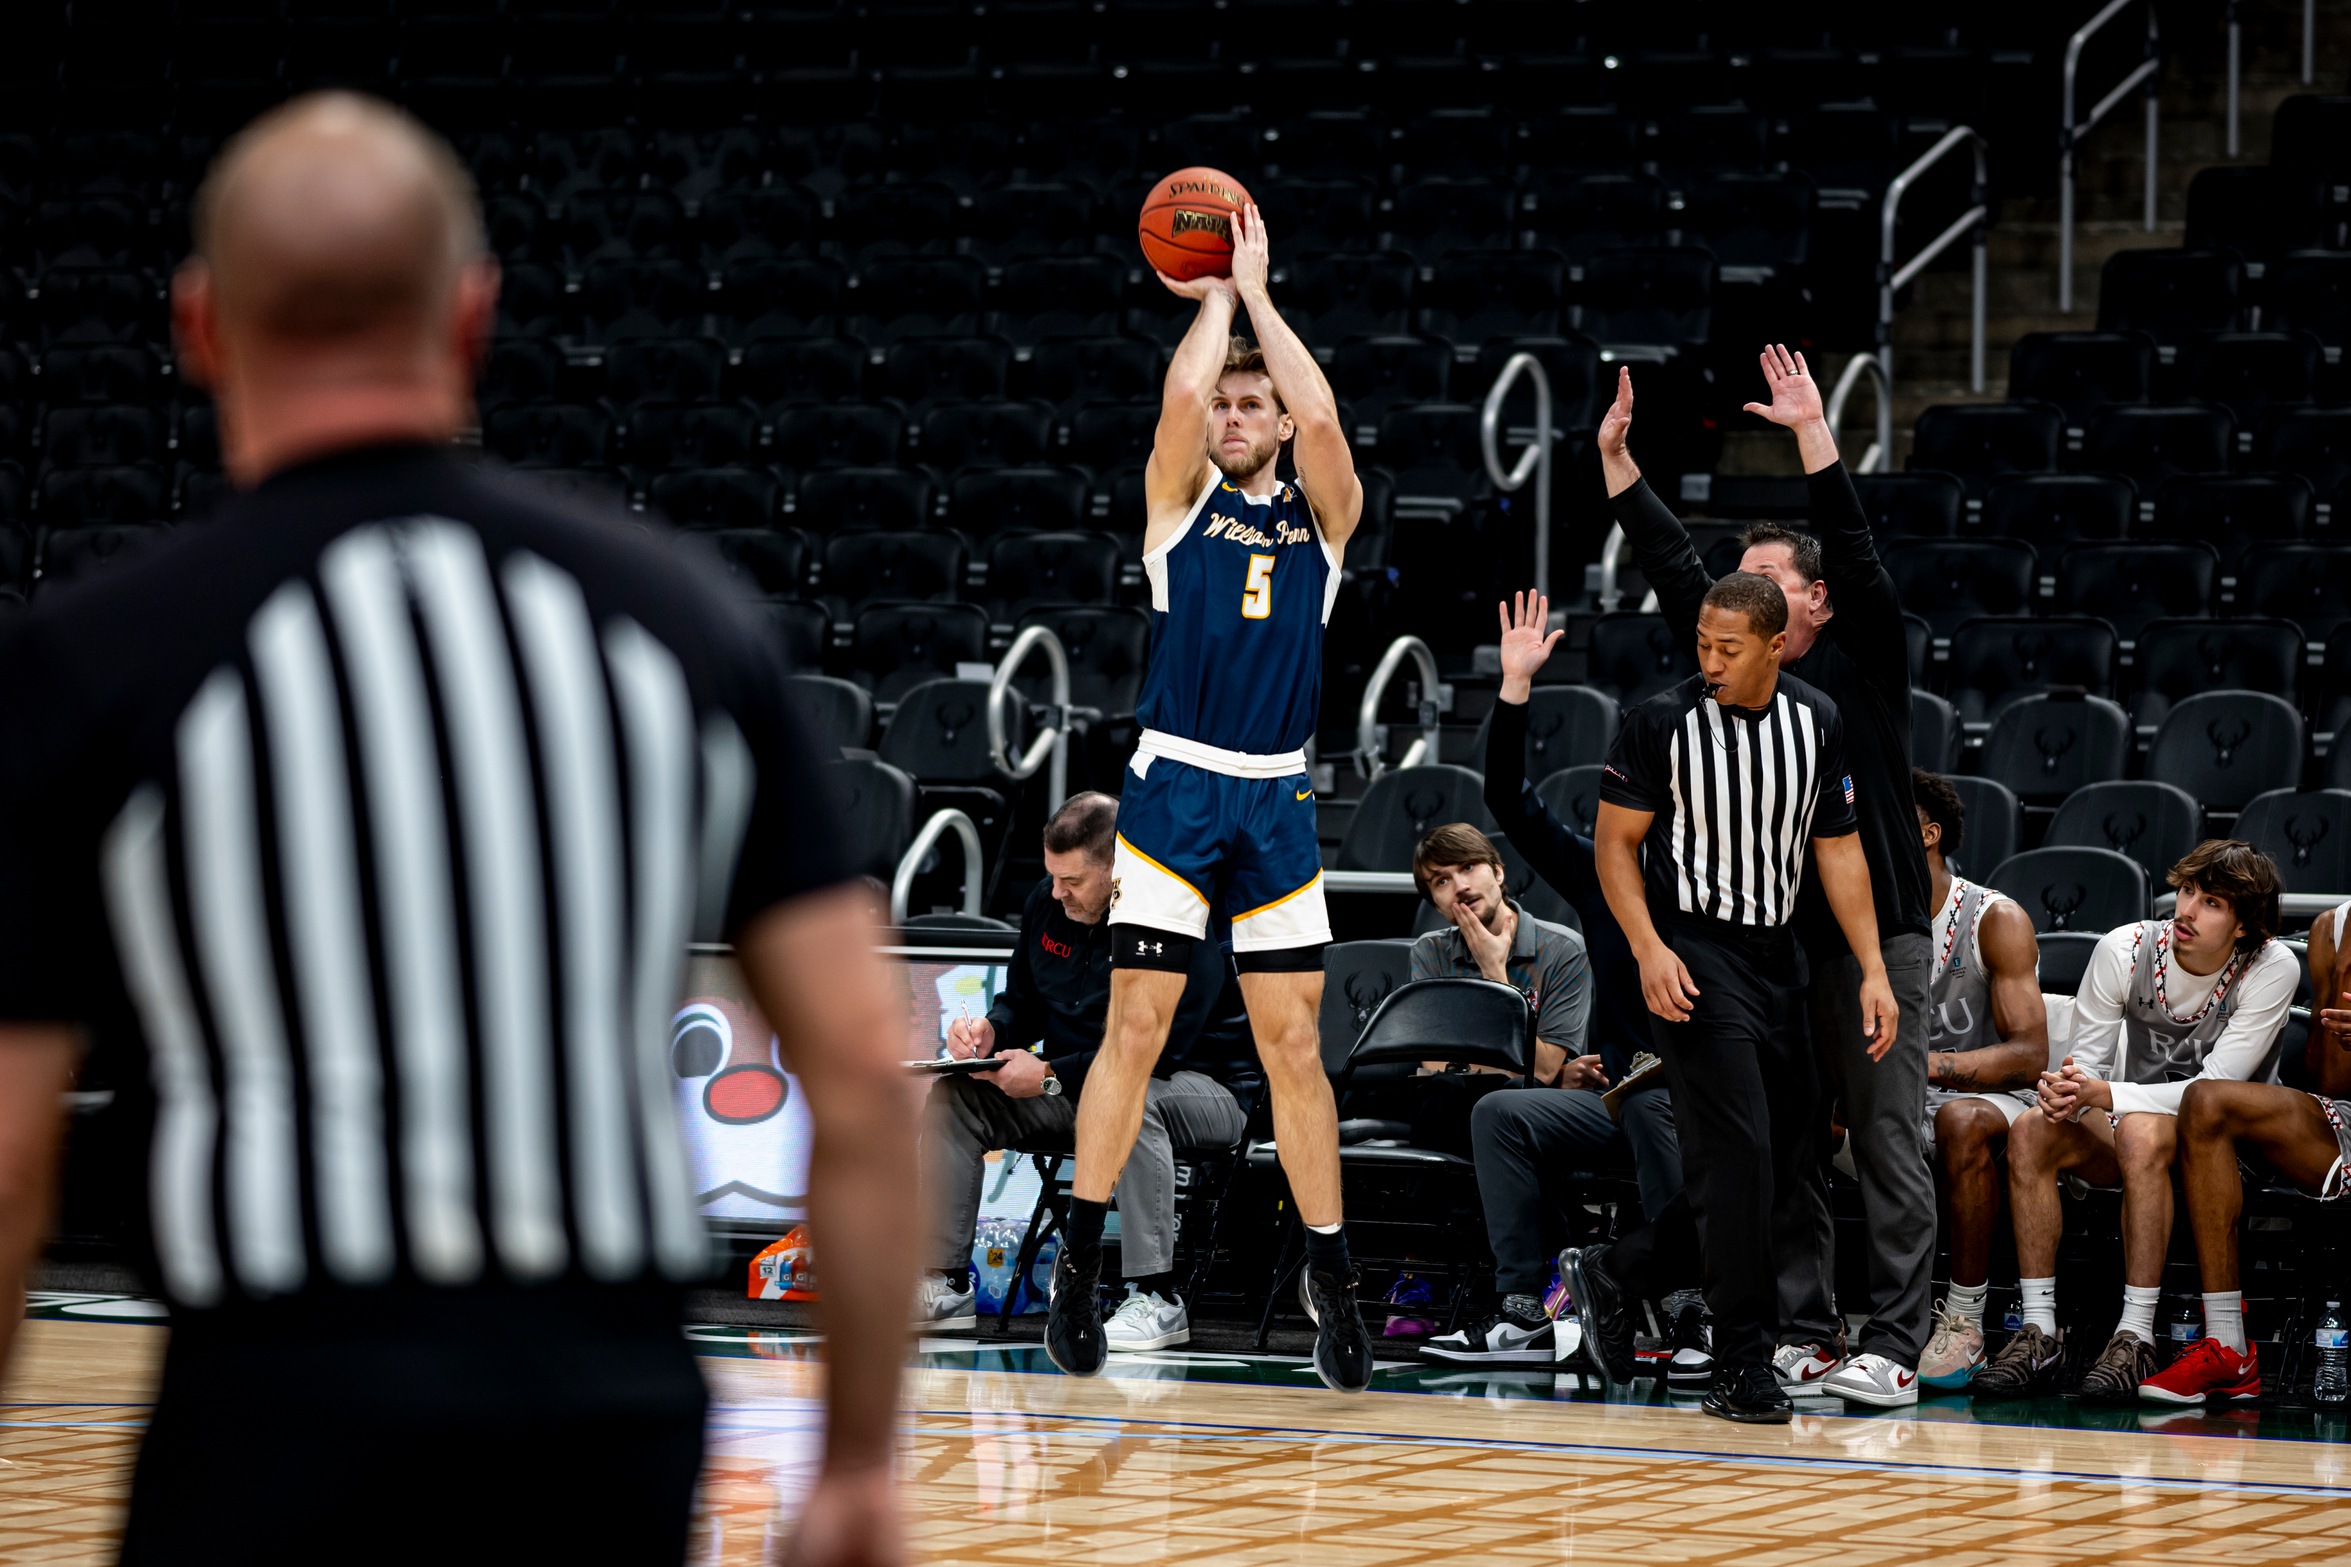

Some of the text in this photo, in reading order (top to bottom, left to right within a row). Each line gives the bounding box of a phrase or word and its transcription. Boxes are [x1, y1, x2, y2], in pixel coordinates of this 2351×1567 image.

[1169, 181, 1246, 209] SPALDING
[1276, 520, 1310, 545] Penn
[1242, 554, 1275, 619] 5
[1046, 939, 1072, 959] RCU
[993, 1252, 1004, 1262] 24
[762, 1266, 773, 1275] 12
[783, 1273, 805, 1281] G G
